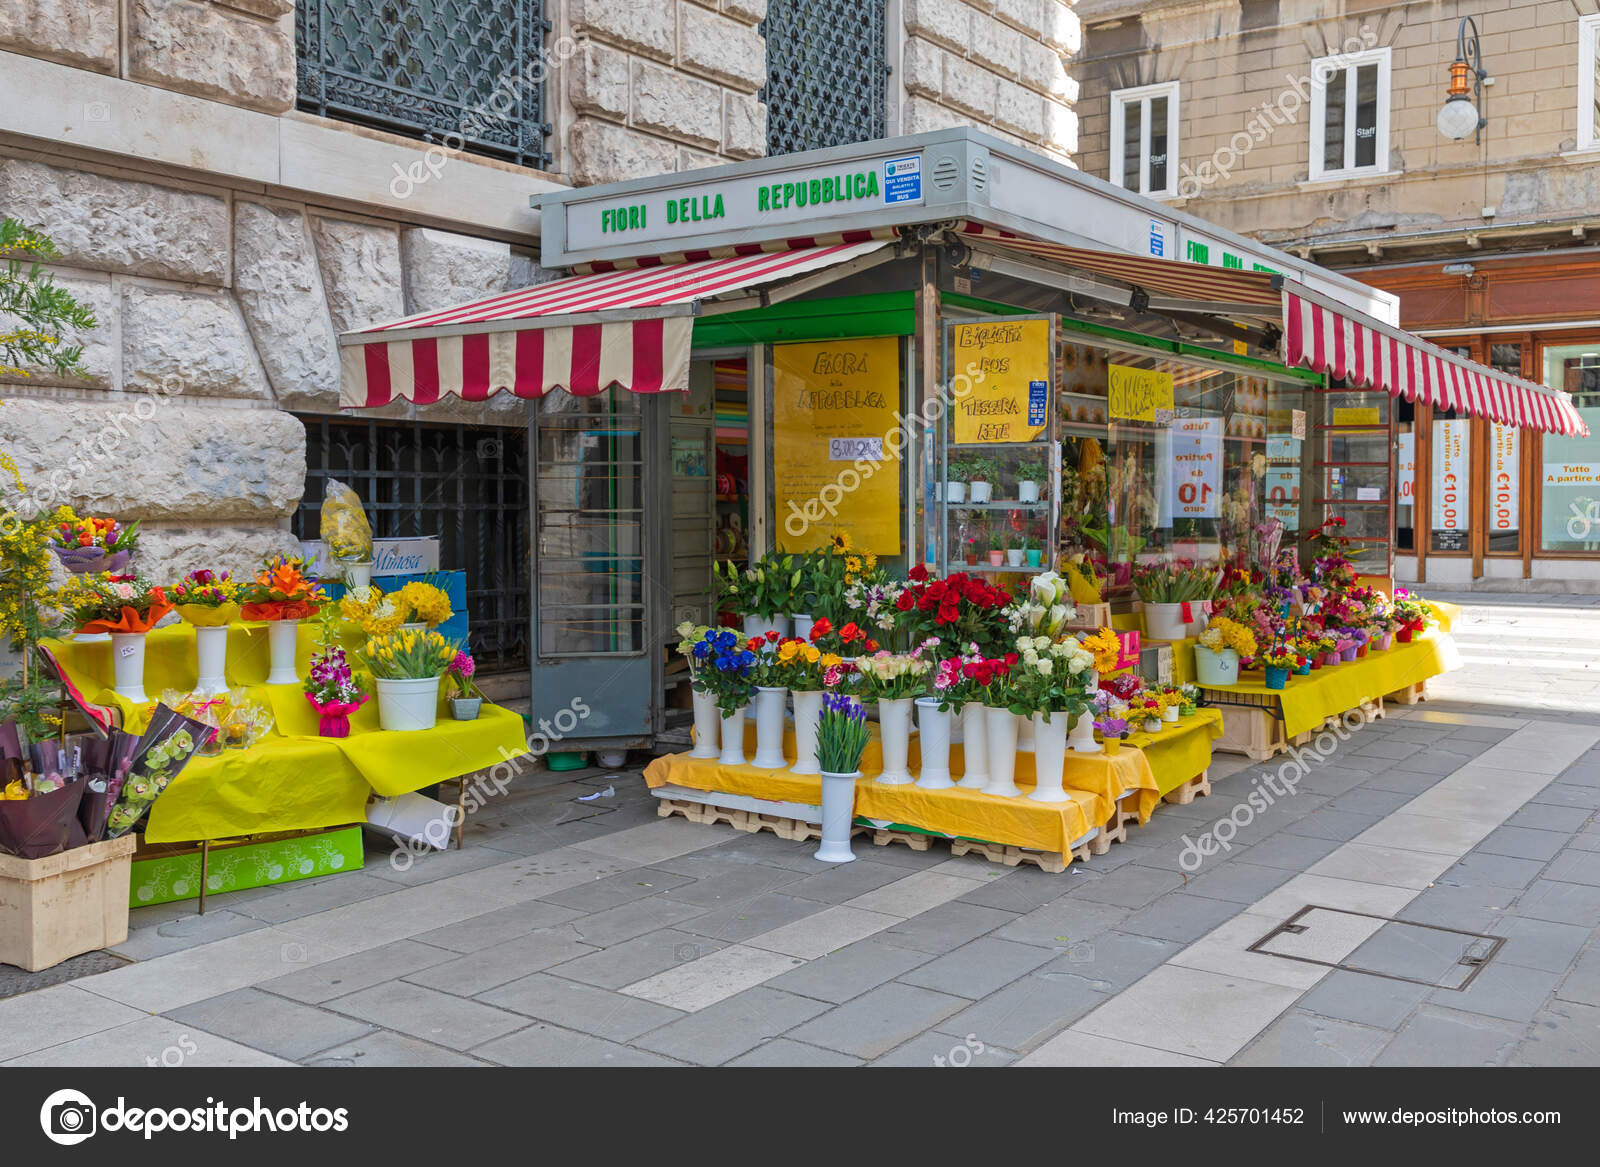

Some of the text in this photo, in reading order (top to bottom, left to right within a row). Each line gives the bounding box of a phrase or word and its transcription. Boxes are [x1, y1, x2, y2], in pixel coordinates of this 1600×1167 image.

[1356, 126, 1376, 137] Staff
[897, 174, 920, 183] VENDITA
[601, 170, 880, 233] FIORI DELLA REPUBBLICA
[980, 356, 1011, 375] BUS
[1453, 434, 1461, 458] Tutto
[1506, 431, 1514, 456] Tutto
[1547, 474, 1554, 482] A
[1557, 474, 1593, 483] partire
[1563, 465, 1590, 473] Tutto
[1442, 473, 1457, 529] €10,00
[1494, 472, 1511, 529] €10,00
[370, 547, 423, 571] Mimosa
